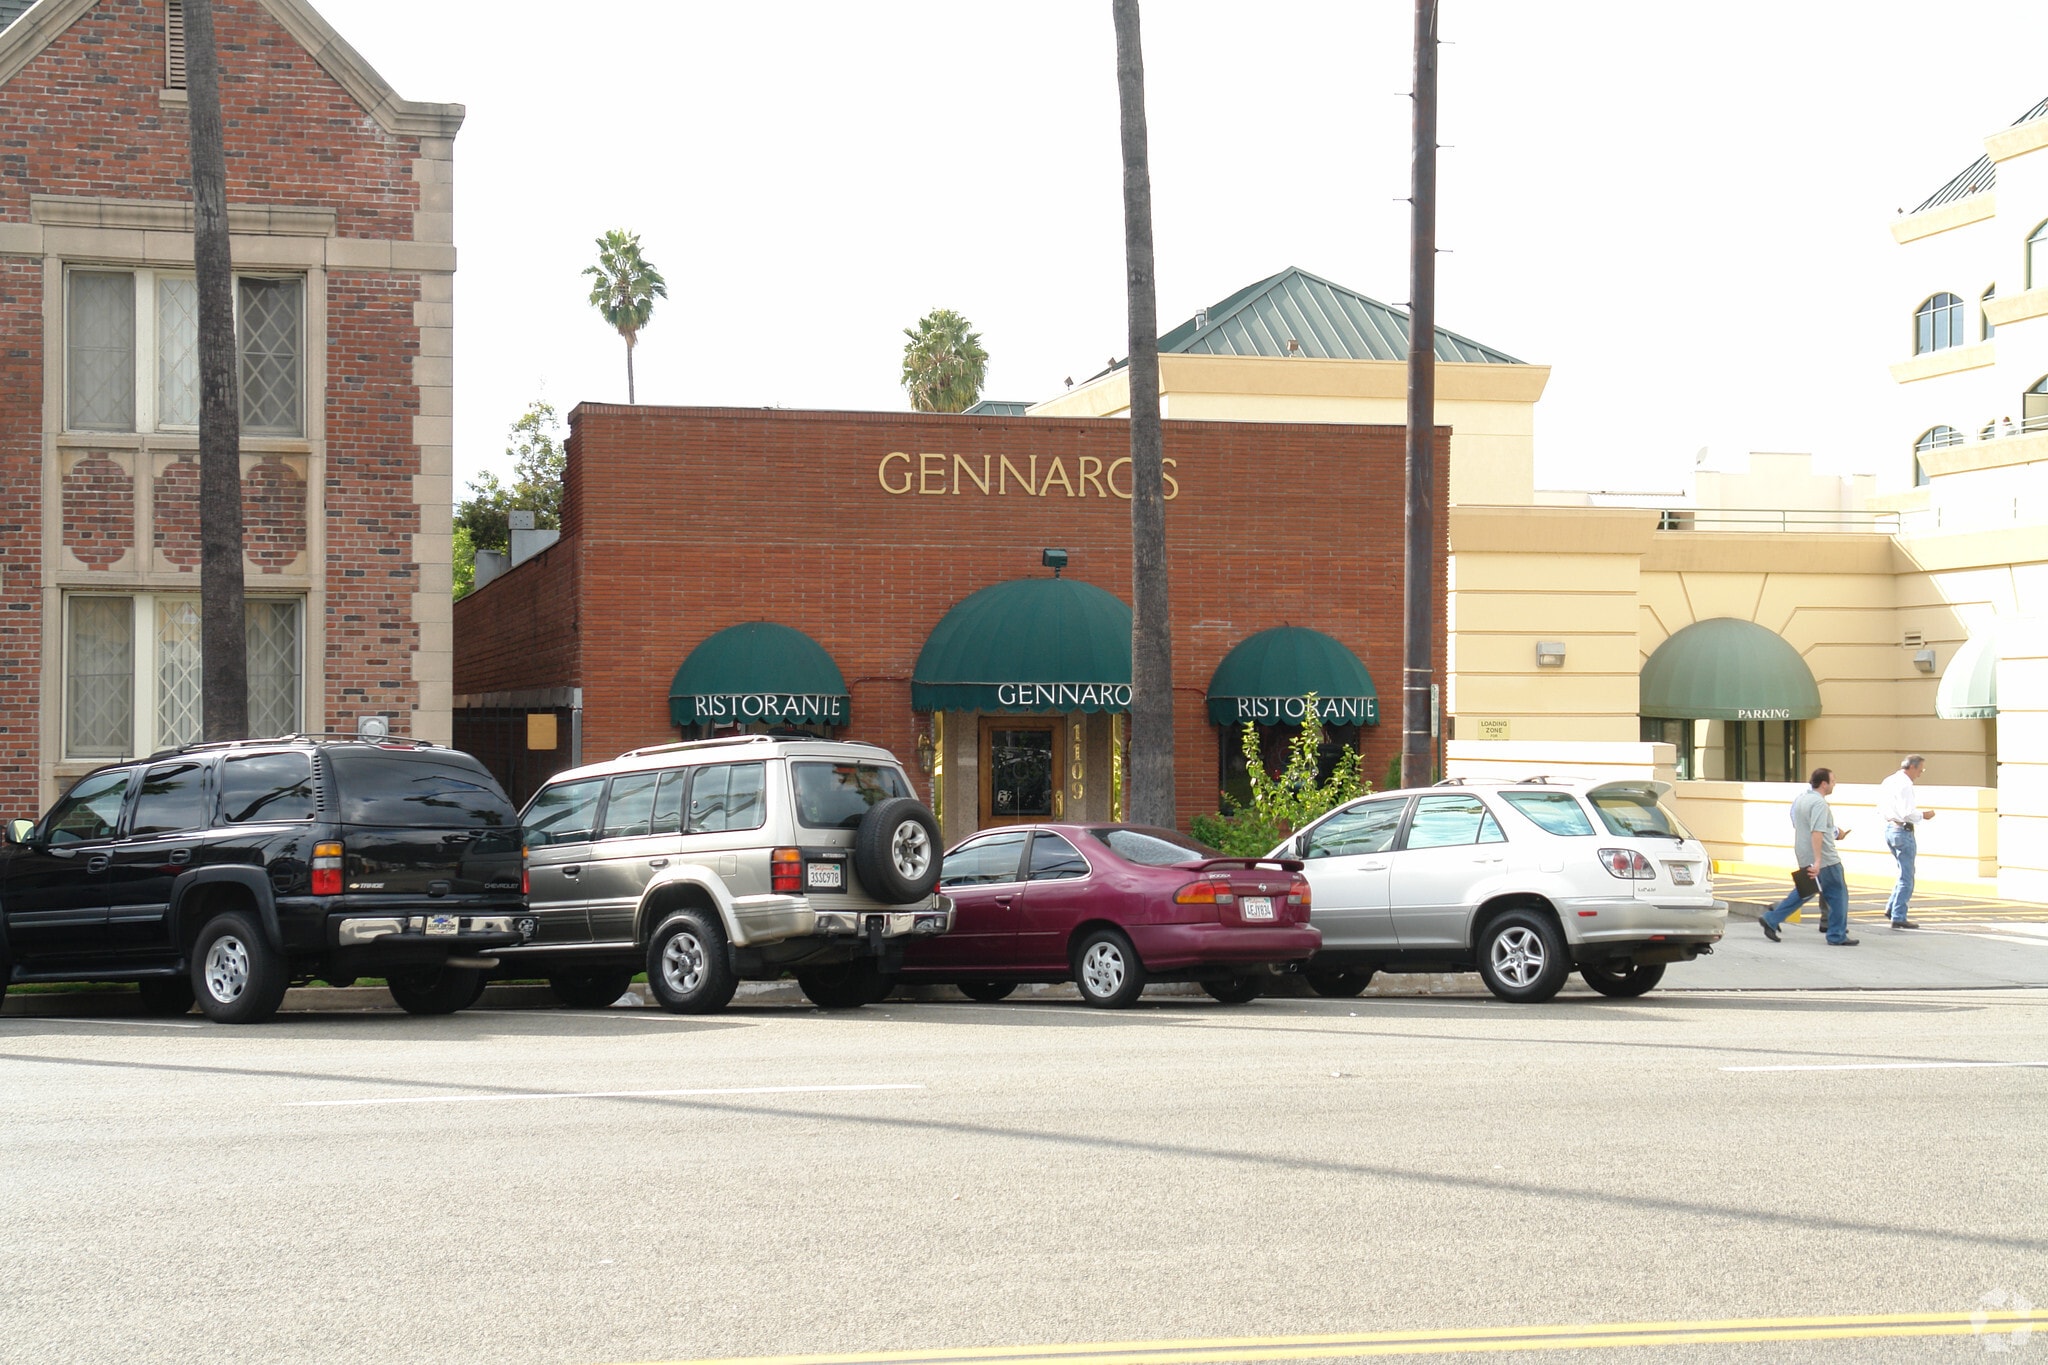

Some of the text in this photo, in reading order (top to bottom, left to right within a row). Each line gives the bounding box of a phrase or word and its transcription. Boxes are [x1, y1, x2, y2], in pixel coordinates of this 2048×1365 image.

[878, 451, 1179, 501] GENNAROS
[695, 694, 840, 716] RISTORANTE
[997, 683, 1132, 705] GENNARO
[1237, 697, 1375, 718] RISTORANTE
[1738, 708, 1790, 719] PARKING
[1071, 723, 1084, 800] 1109
